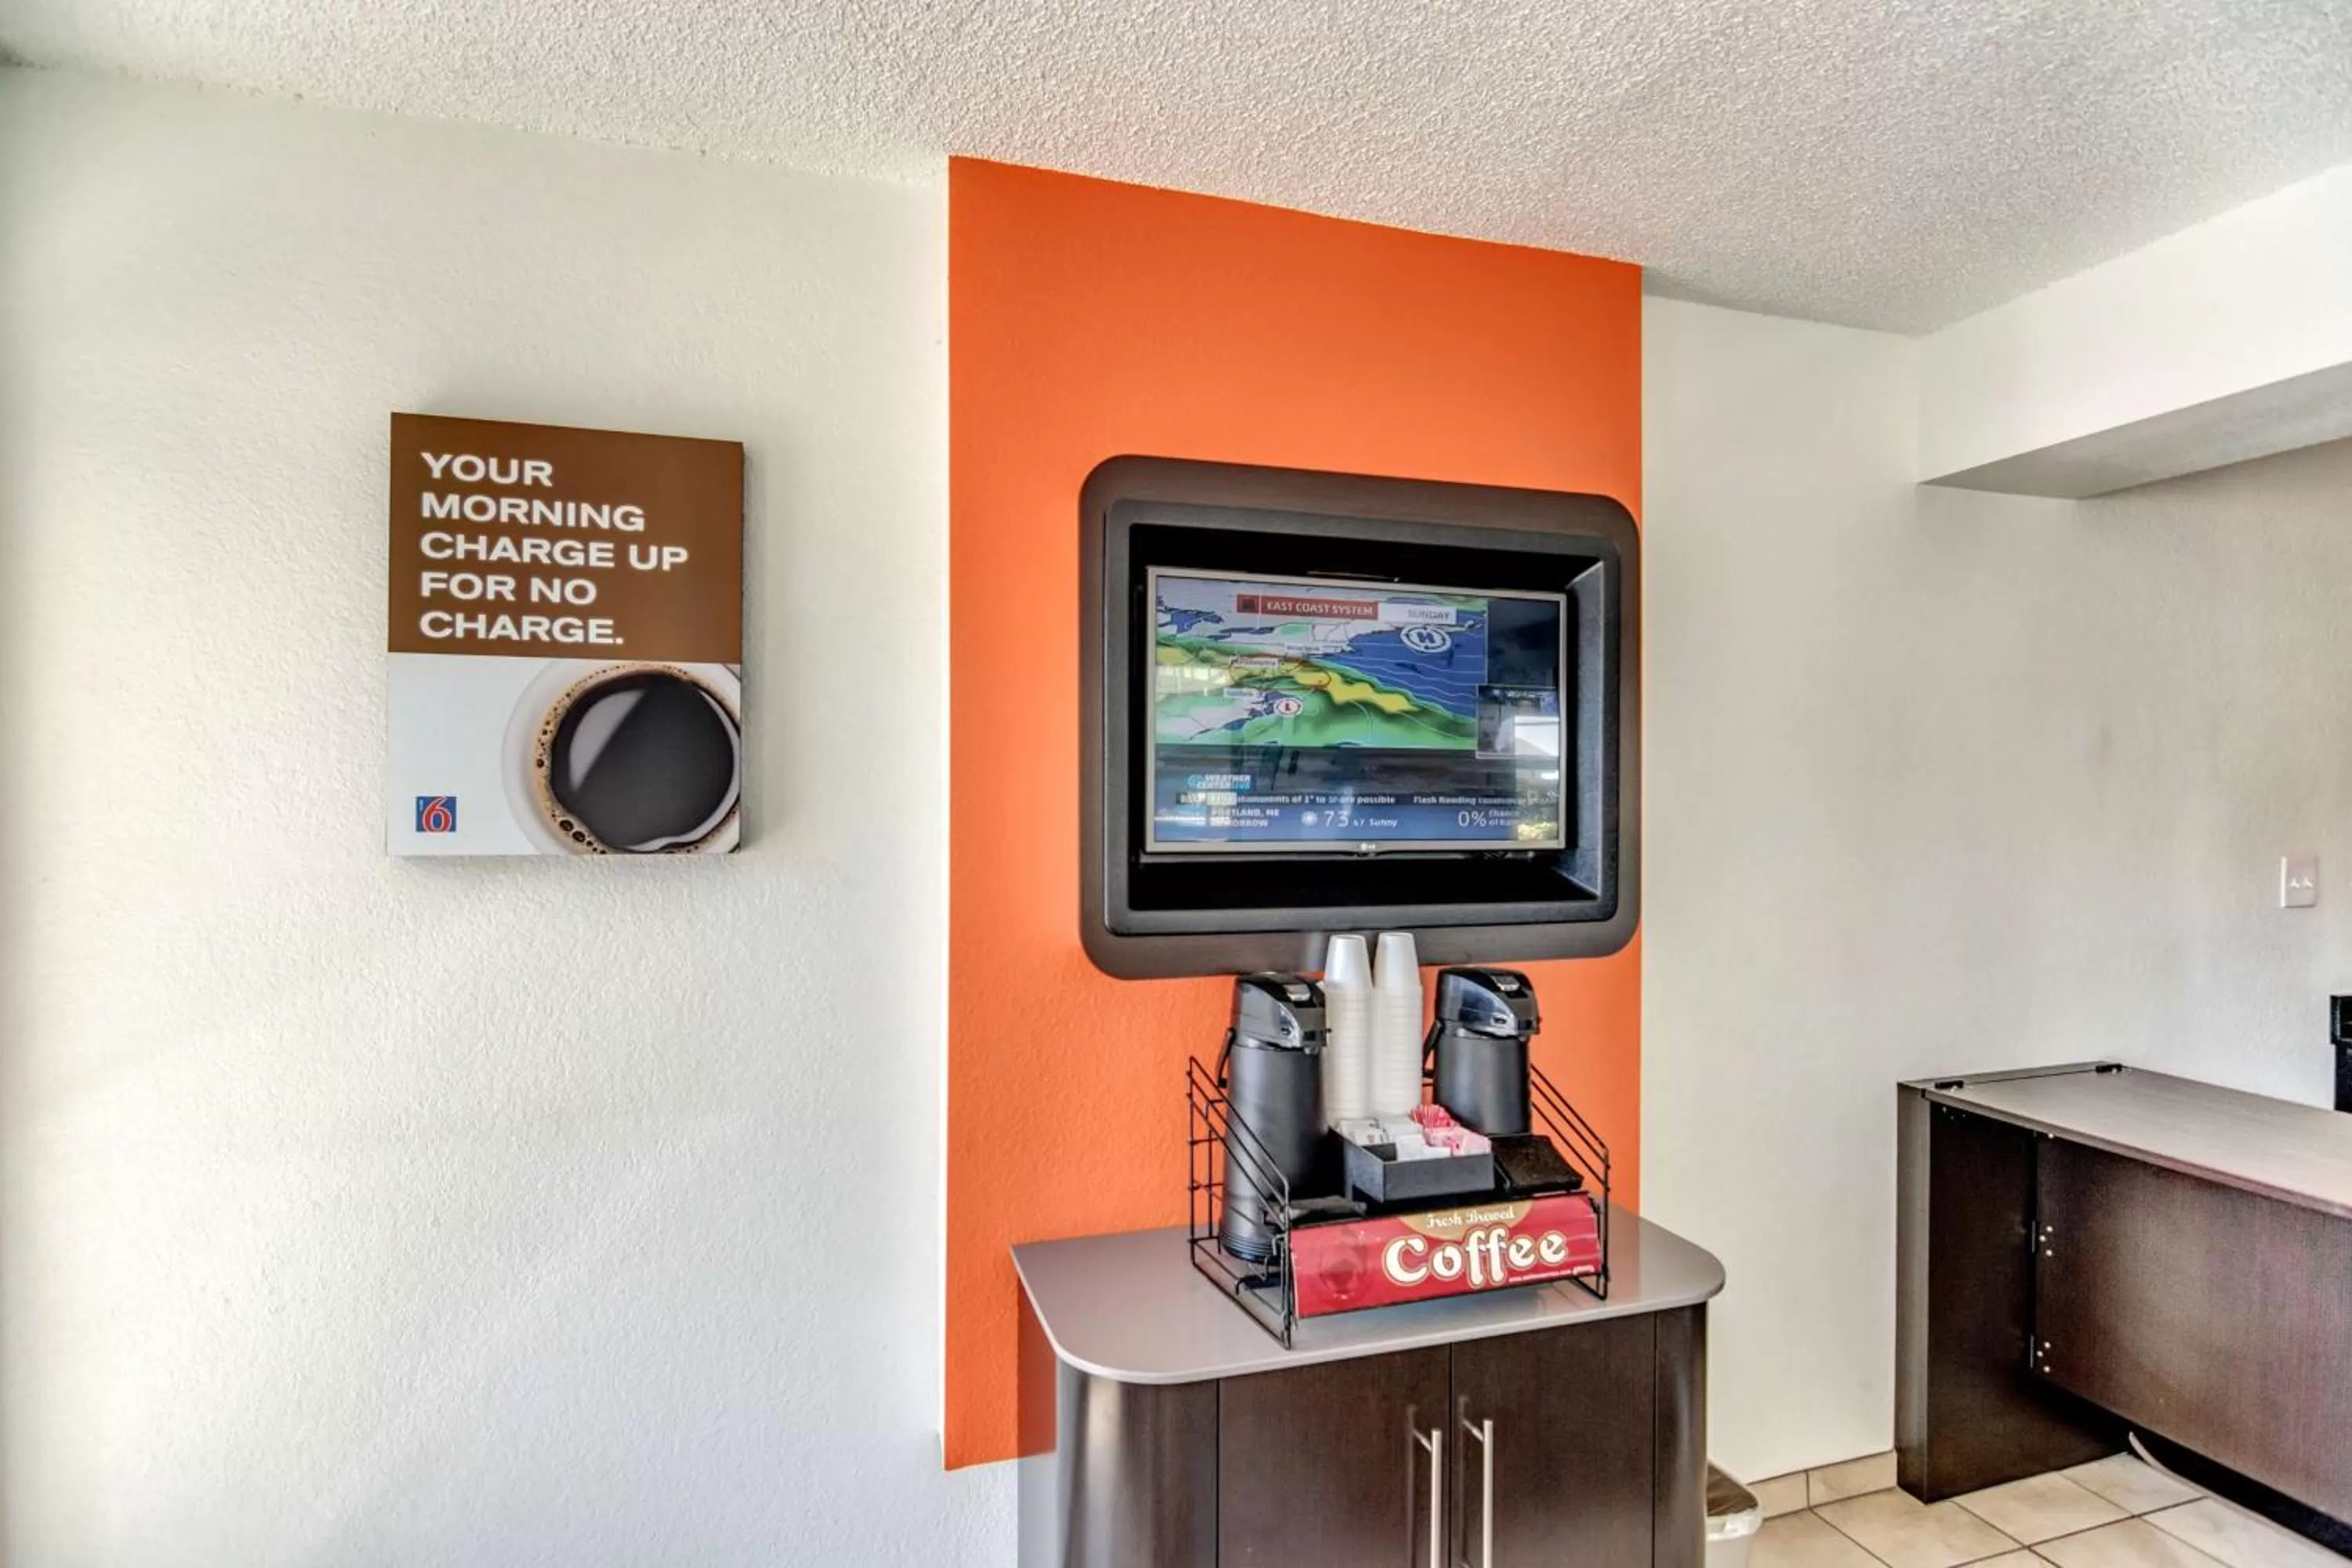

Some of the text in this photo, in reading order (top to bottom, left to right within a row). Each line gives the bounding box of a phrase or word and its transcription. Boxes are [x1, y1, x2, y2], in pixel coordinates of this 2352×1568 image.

[420, 452, 554, 487] YOUR
[421, 492, 645, 532] MORNING
[420, 532, 689, 571] CHARGE UP
[420, 572, 597, 605] FOR NO
[1266, 601, 1373, 616] EAST COAST SYSTEM
[1408, 608, 1450, 620] SUNDAY
[419, 611, 625, 645] CHARGE.
[423, 794, 452, 834] 6
[1323, 810, 1349, 828] 73
[1369, 818, 1399, 828] Sunny
[1457, 811, 1486, 828] 0%
[1425, 1206, 1515, 1229] Fresh Brewed
[1384, 1225, 1568, 1287] Coffee
